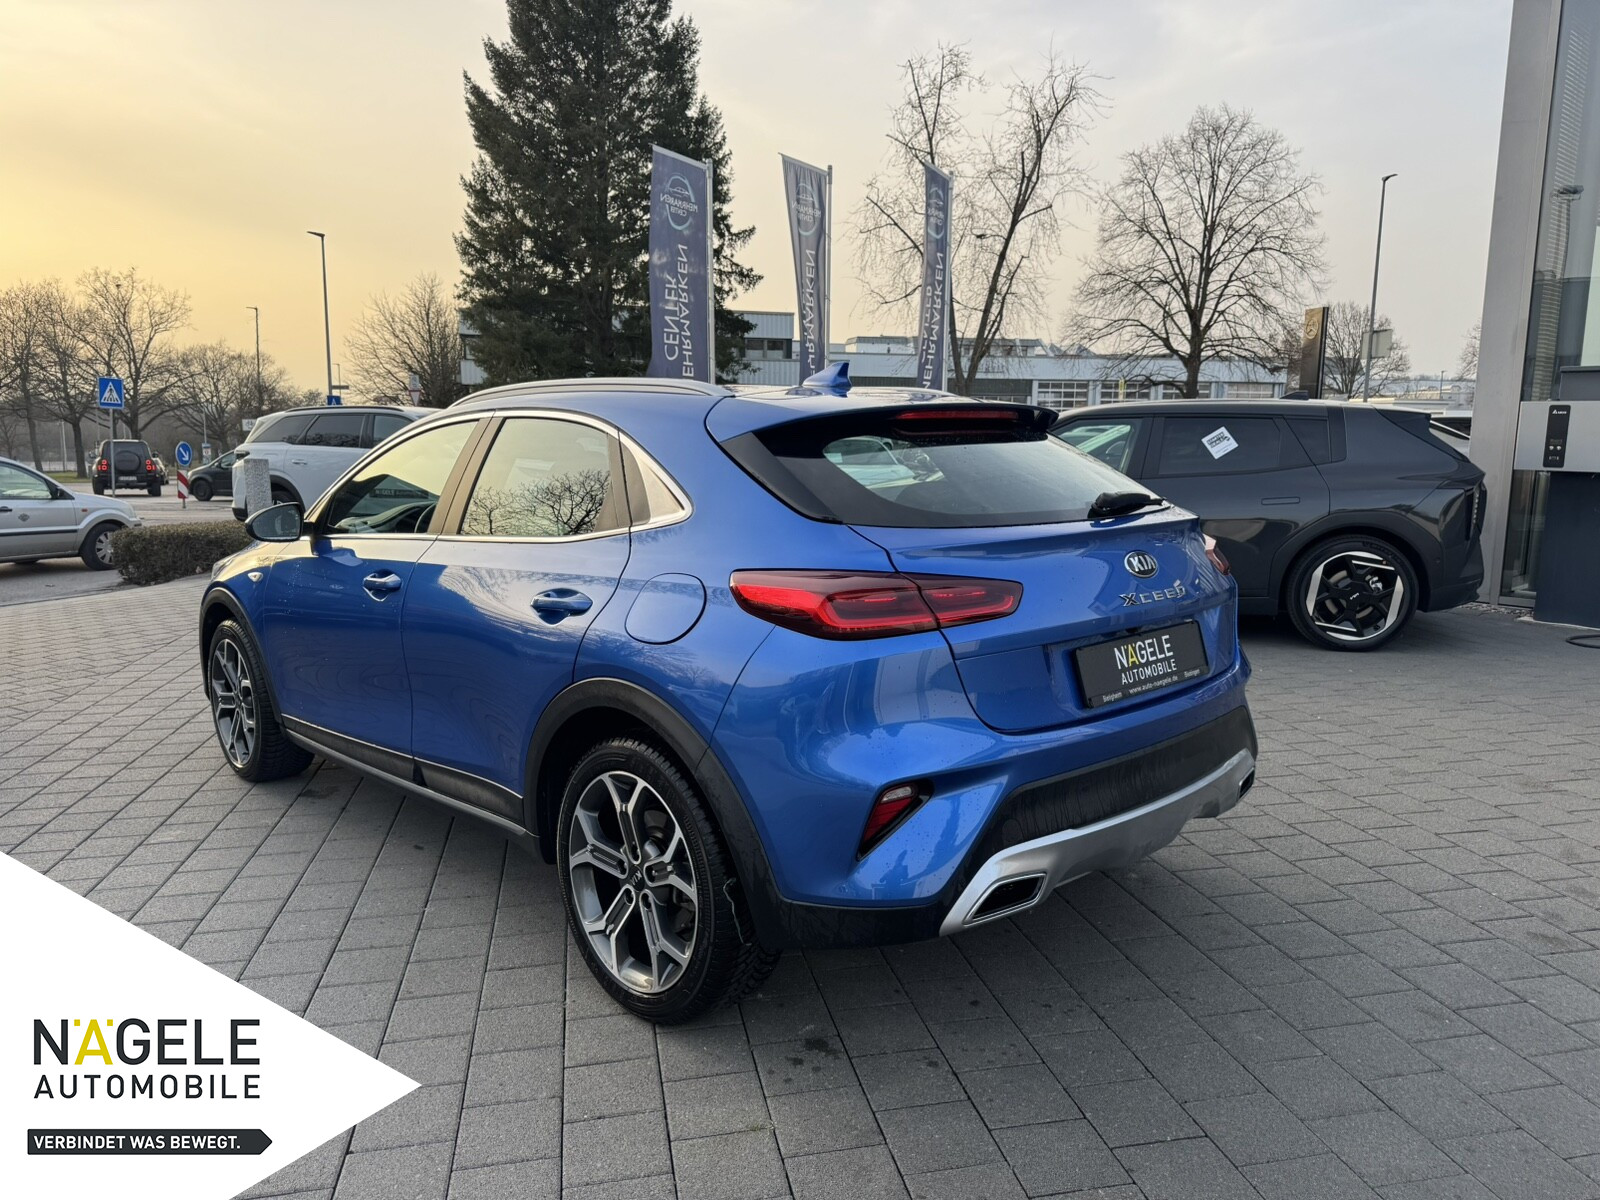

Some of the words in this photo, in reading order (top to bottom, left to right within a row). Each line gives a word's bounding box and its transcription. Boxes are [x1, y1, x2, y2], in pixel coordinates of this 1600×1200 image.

[1129, 555, 1156, 572] KIA
[1114, 635, 1174, 669] NÄGELE
[1121, 659, 1178, 685] AUTOMOBILE
